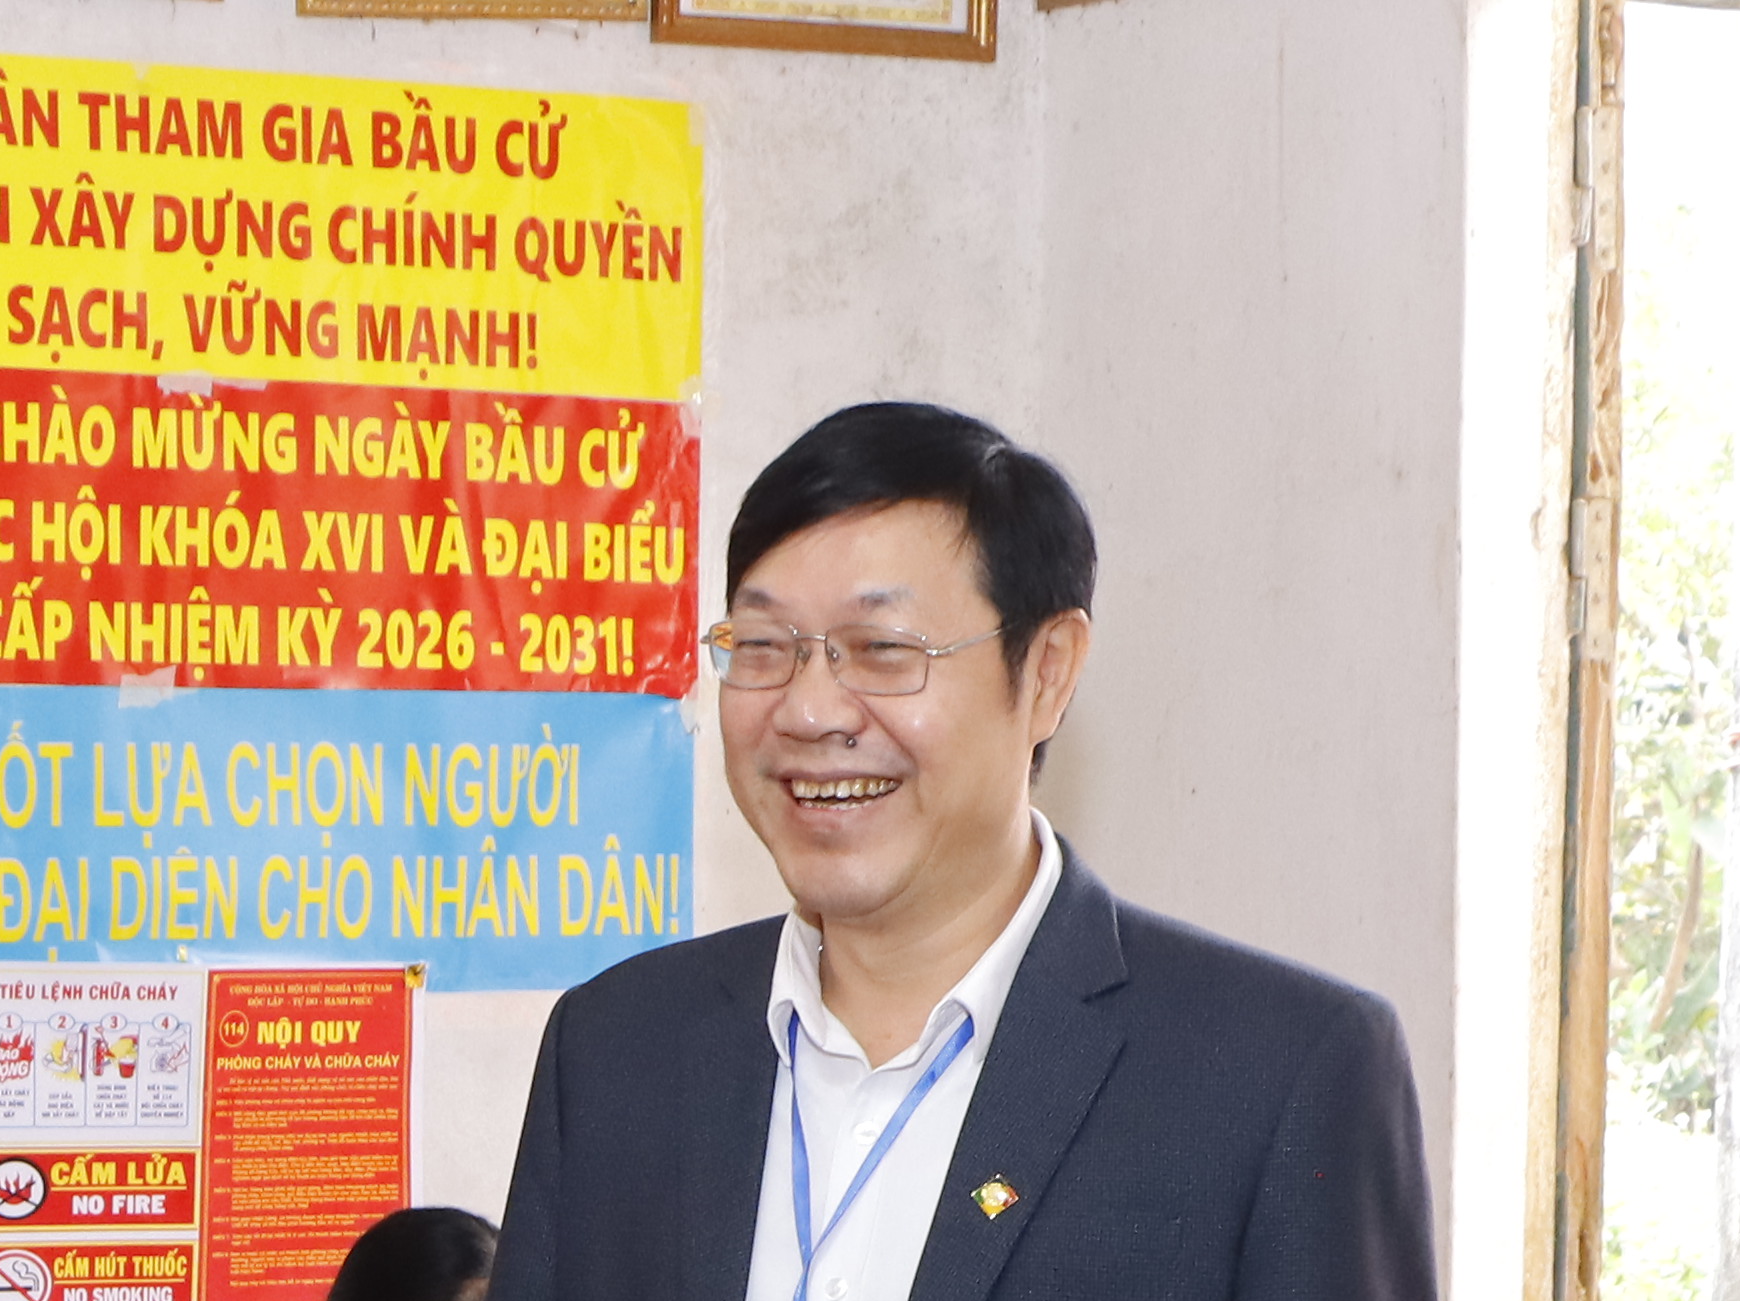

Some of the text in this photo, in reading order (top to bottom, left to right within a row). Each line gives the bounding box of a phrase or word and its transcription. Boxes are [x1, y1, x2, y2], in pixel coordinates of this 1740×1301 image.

[78, 92, 242, 158] THAM
[263, 104, 353, 166] GIA
[372, 91, 476, 174] BẦU
[496, 100, 567, 180] CỬ
[30, 172, 134, 249] XÂY
[154, 189, 311, 269] DỰNG
[328, 193, 496, 270] CHÍNH
[515, 201, 682, 282] QUYỀN
[8, 285, 163, 362] SẠCH,
[184, 280, 338, 358] VỮNG
[358, 305, 537, 373] MẠNH!
[132, 390, 297, 474] MỪNG
[315, 402, 451, 479] NGÀY
[465, 402, 564, 485] BẦU
[579, 408, 645, 489] CỬ
[32, 485, 121, 579] HỘI
[140, 490, 286, 569] KHÓA
[301, 511, 383, 573] XVI
[399, 499, 472, 575] VÀ
[482, 518, 568, 592] ĐẠI
[584, 500, 684, 586] BIỂU
[89, 592, 259, 675] NHIỆM
[278, 595, 342, 667] KỲ
[357, 608, 475, 670] 2026
[520, 613, 633, 676] 2031!
[95, 744, 211, 845] LỰA
[227, 743, 383, 846] CHỌN
[405, 726, 578, 828] NGƯỜI
[110, 842, 237, 953] DIỆN
[259, 854, 372, 940] CHO
[393, 838, 539, 937] NHÂN
[559, 837, 678, 936] DÂN!
[0, 980, 178, 1002] TIÊU LỆNH CHỮA CHÁY
[5, 1016, 12, 1028] 1
[58, 1016, 66, 1028] 2
[110, 1016, 118, 1029] 3
[161, 1016, 169, 1029] 4
[224, 1022, 244, 1036] 114
[257, 1017, 361, 1049] NỘI QUY
[217, 1051, 400, 1070] PHÒNG CHÁY VÀ CHỮA CHÁY
[50, 1153, 116, 1185] CẤM
[128, 1153, 187, 1185] LỬA
[72, 1195, 166, 1215] NO FIRE
[54, 1250, 89, 1277] CẤM
[95, 1251, 127, 1277] HÚT
[132, 1248, 187, 1277] THUỐC
